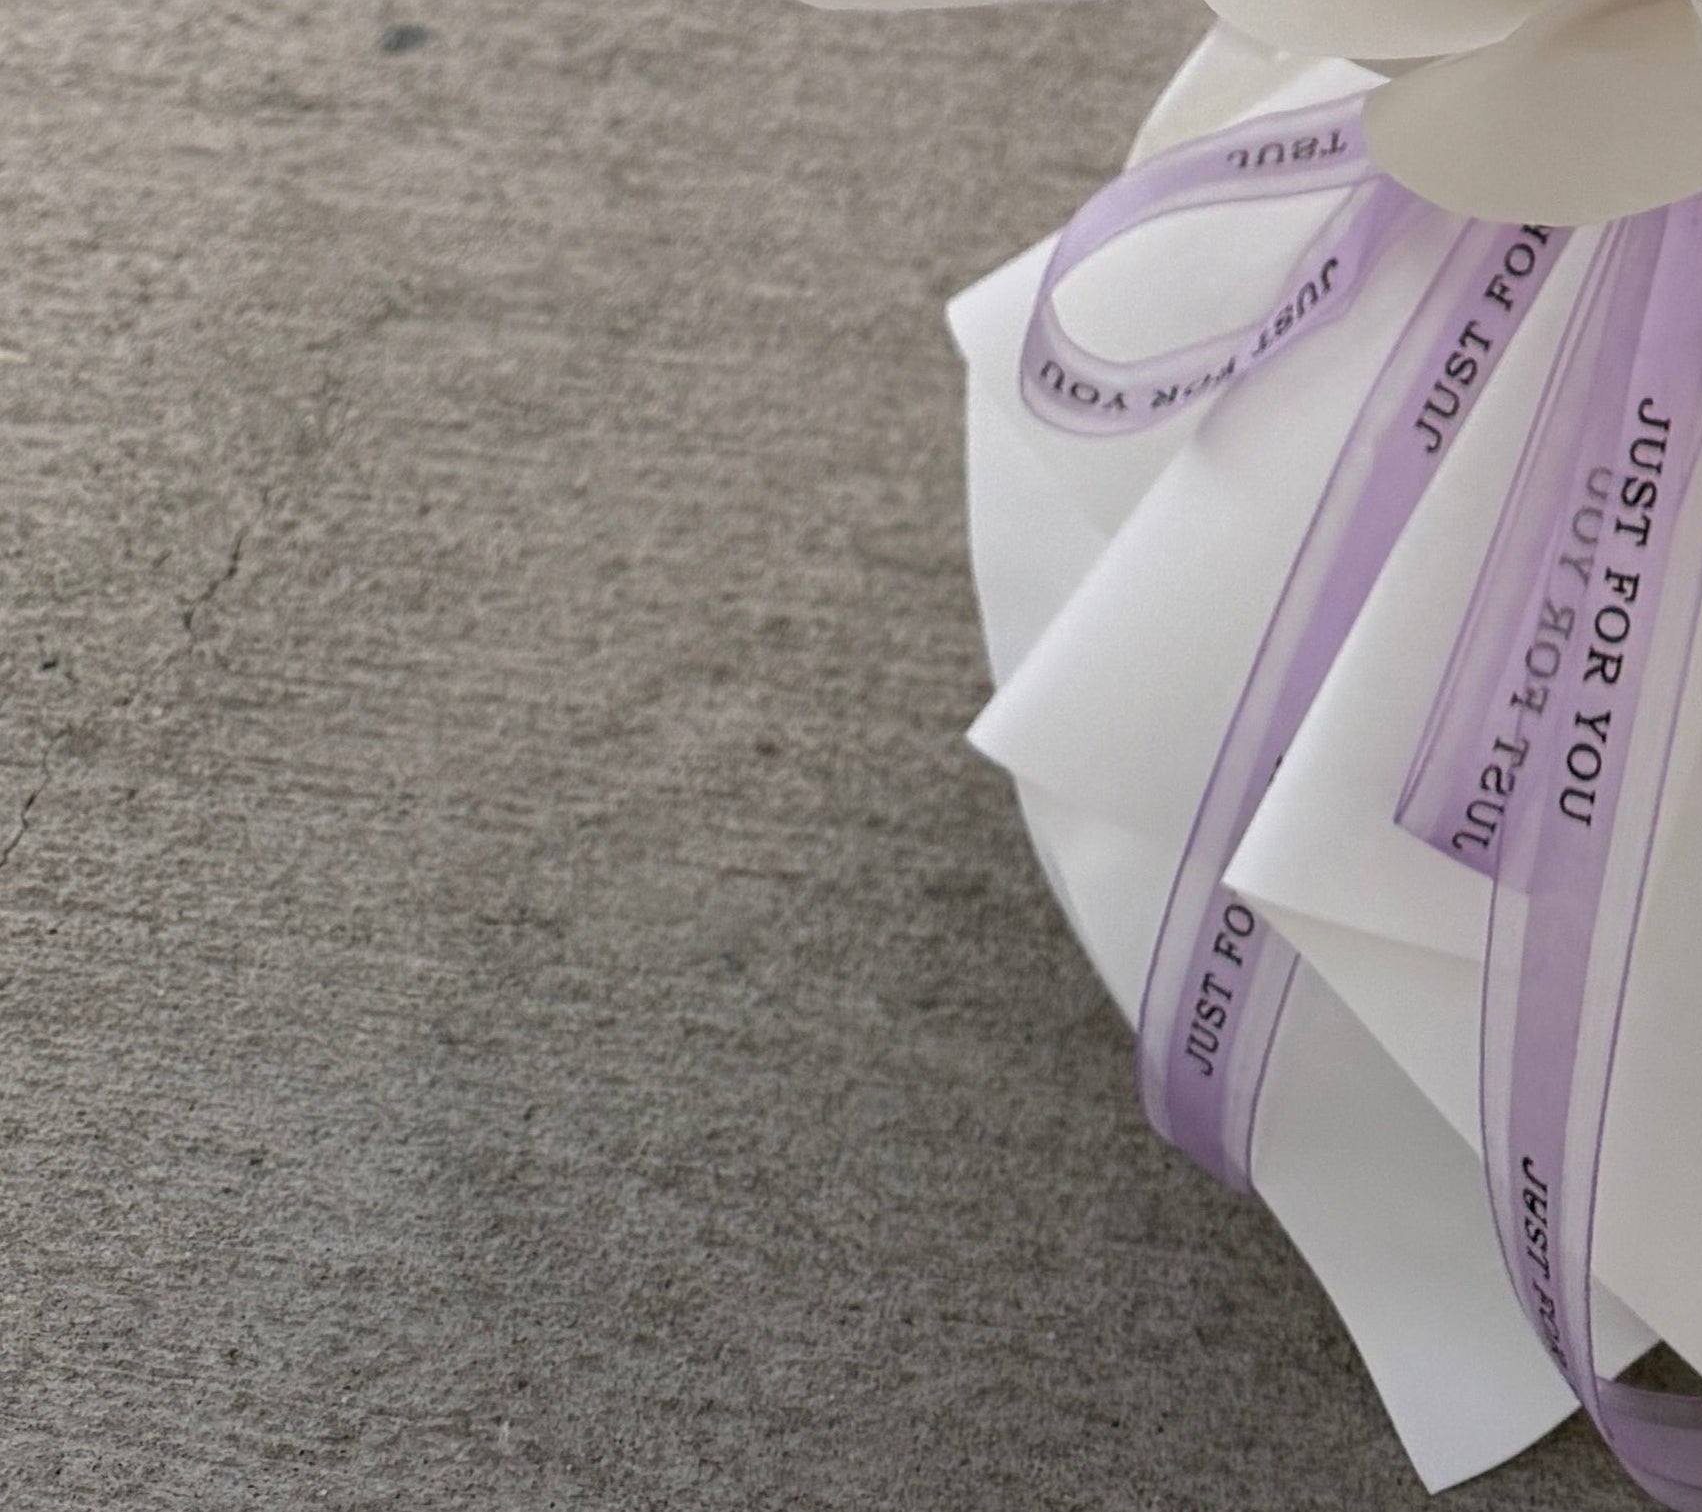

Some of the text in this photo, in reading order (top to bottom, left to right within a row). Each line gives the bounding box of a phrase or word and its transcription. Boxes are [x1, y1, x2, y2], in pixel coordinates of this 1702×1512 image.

[1040, 360, 1129, 410] YOU
[1416, 319, 1494, 454] JUST
[1559, 397, 1671, 829] JUST FOR YOU
[1185, 904, 1255, 1077] JUST FO
[1522, 1156, 1550, 1280] JUST
